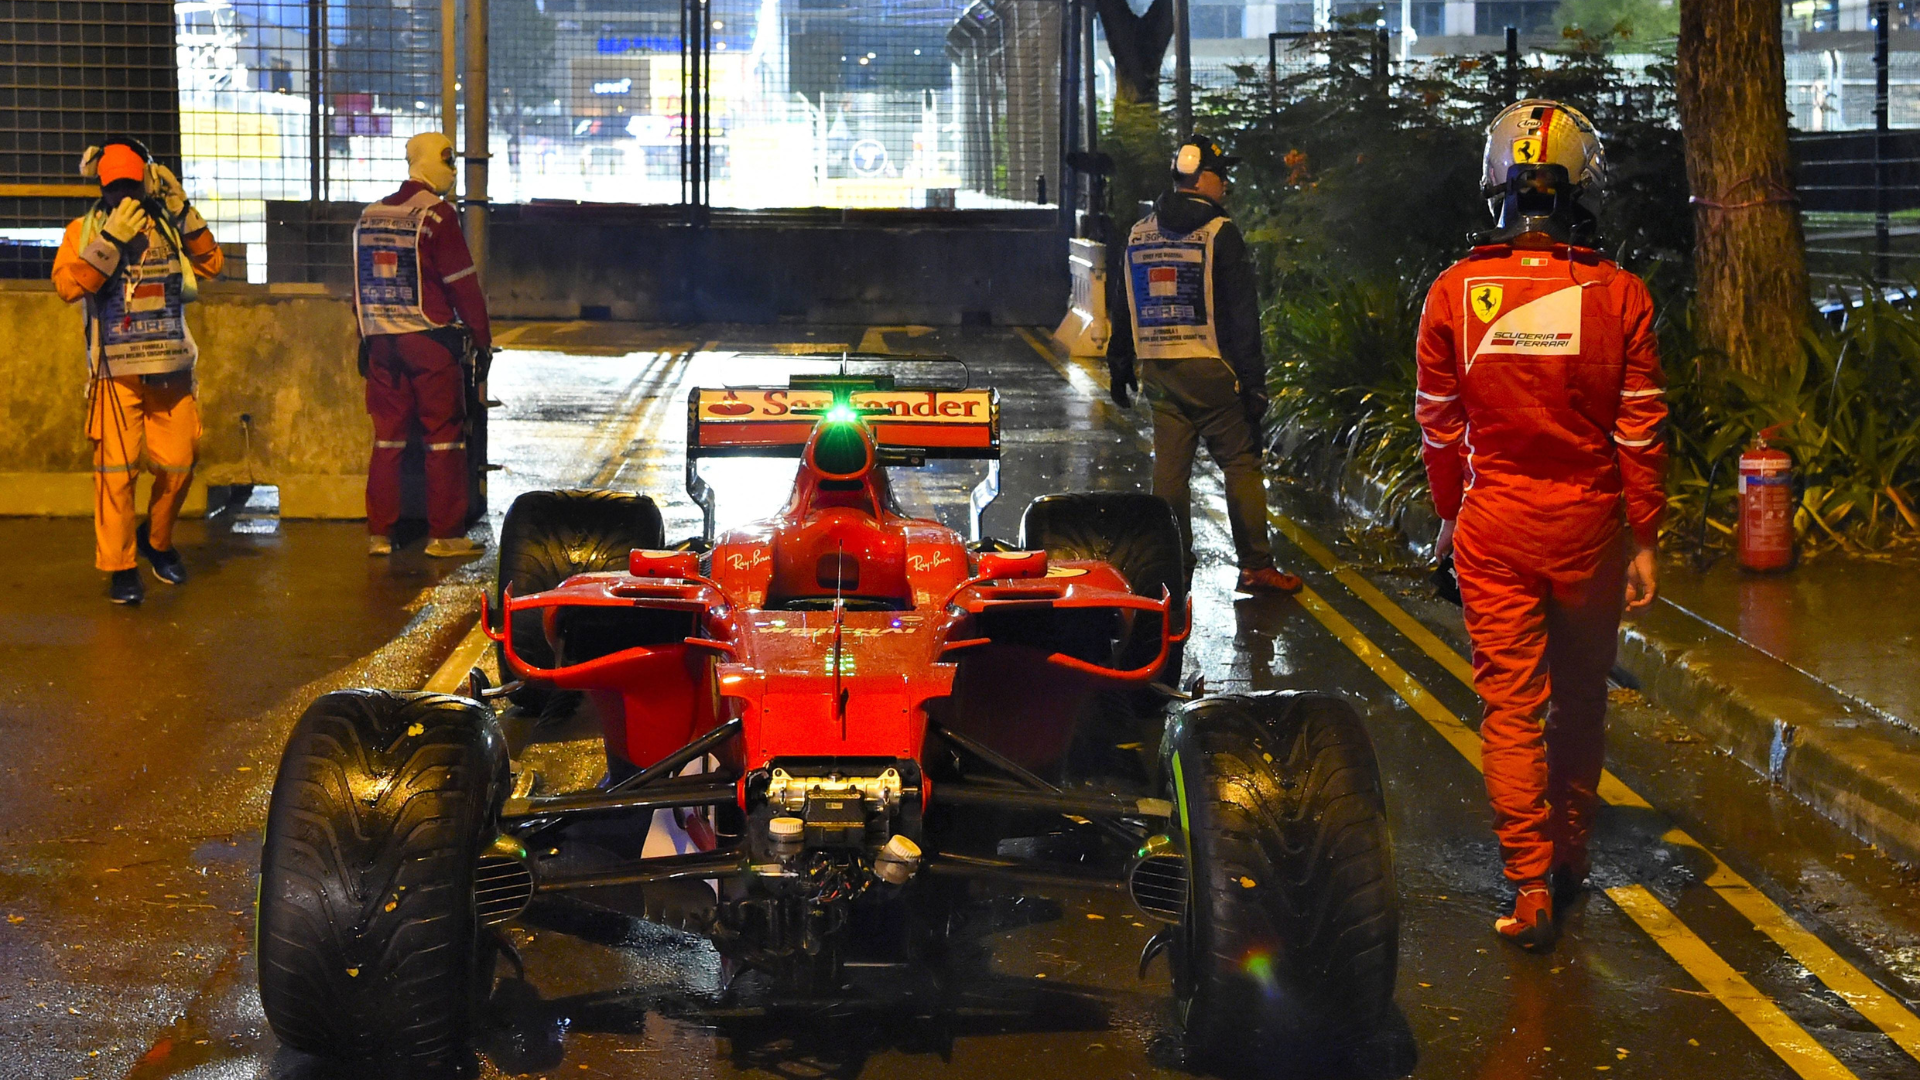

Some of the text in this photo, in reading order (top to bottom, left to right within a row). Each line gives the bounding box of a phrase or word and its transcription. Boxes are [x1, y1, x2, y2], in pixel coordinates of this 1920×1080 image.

[1493, 331, 1555, 340] SCUDERIA
[763, 391, 980, 417] Saander
[727, 549, 771, 570] Ray-Ban
[907, 550, 951, 572] Ray-Ban
